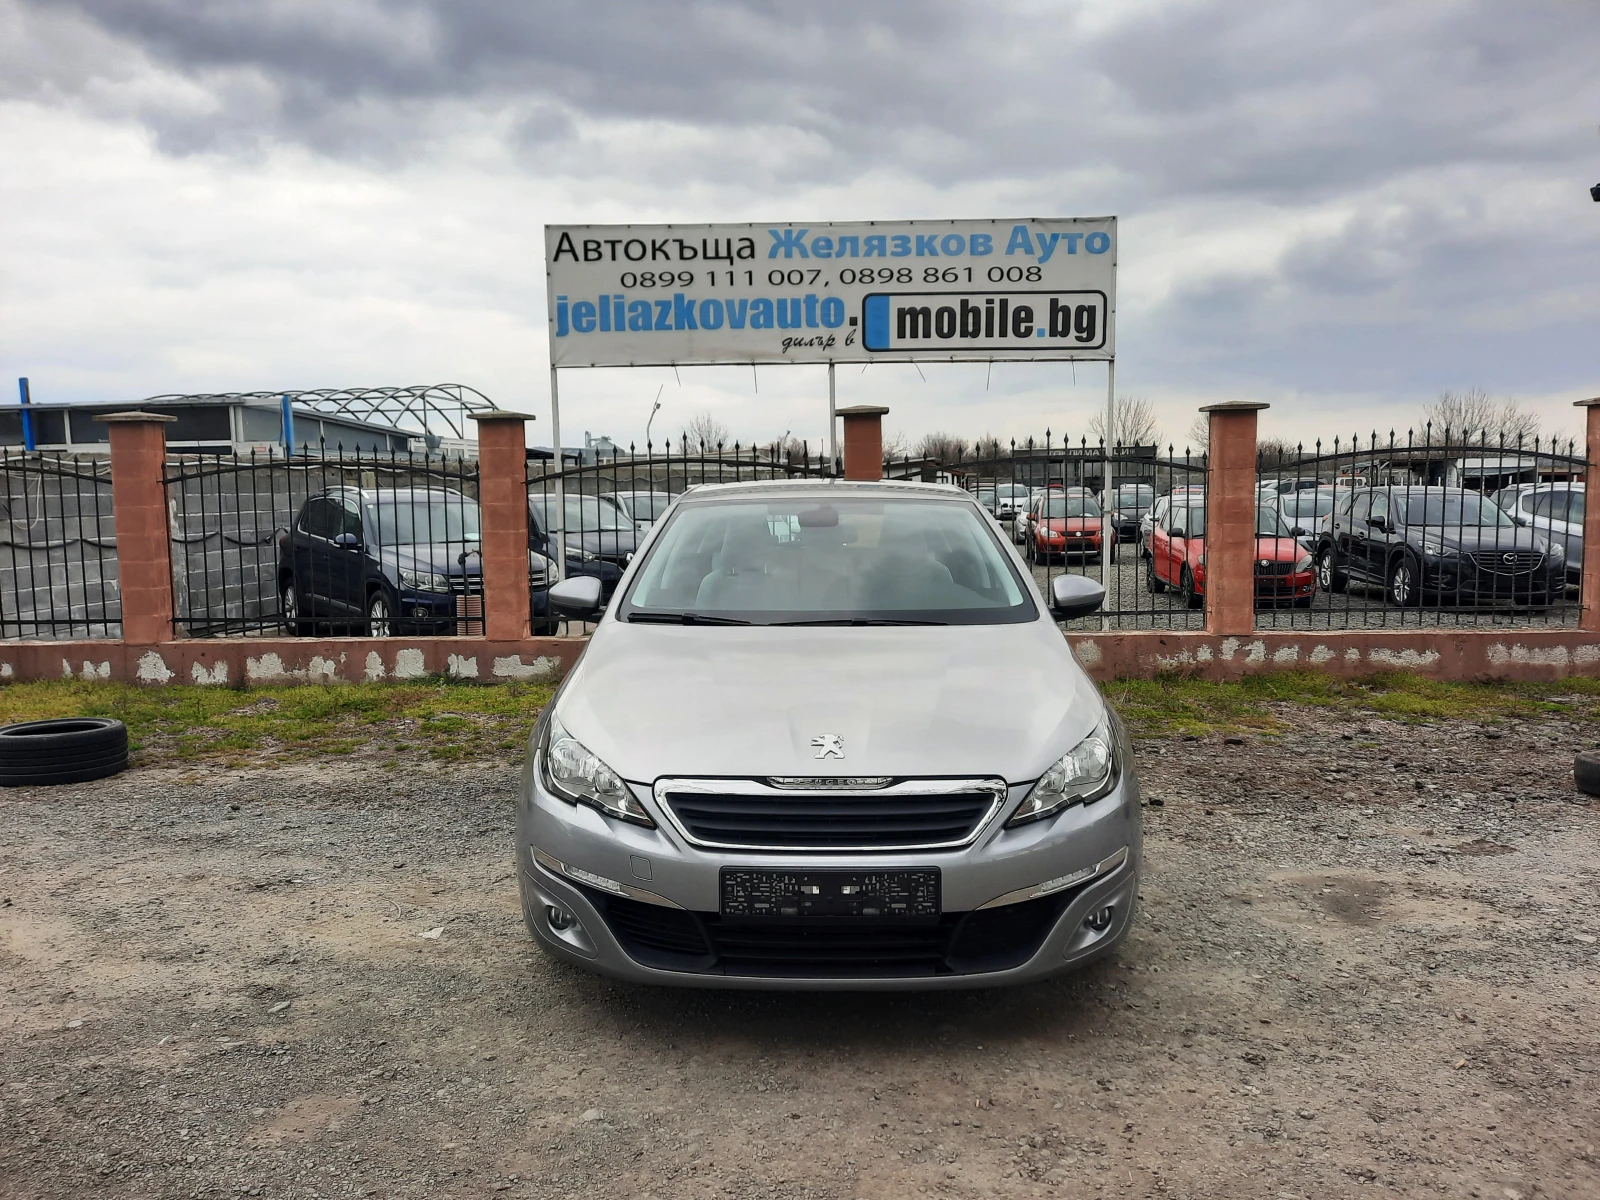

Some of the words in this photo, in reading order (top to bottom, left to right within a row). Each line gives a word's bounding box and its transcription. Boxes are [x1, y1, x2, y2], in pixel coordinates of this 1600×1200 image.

[553, 231, 756, 266] Автокъща
[767, 228, 994, 260] Желязков
[1005, 225, 1111, 264] Ауто
[620, 270, 695, 288] 0899
[706, 269, 753, 287] 111
[767, 269, 830, 288] 007,
[839, 267, 914, 285] 0898
[922, 266, 974, 284] 861
[987, 265, 1043, 283] 008
[896, 297, 1097, 343] mobile.bg
